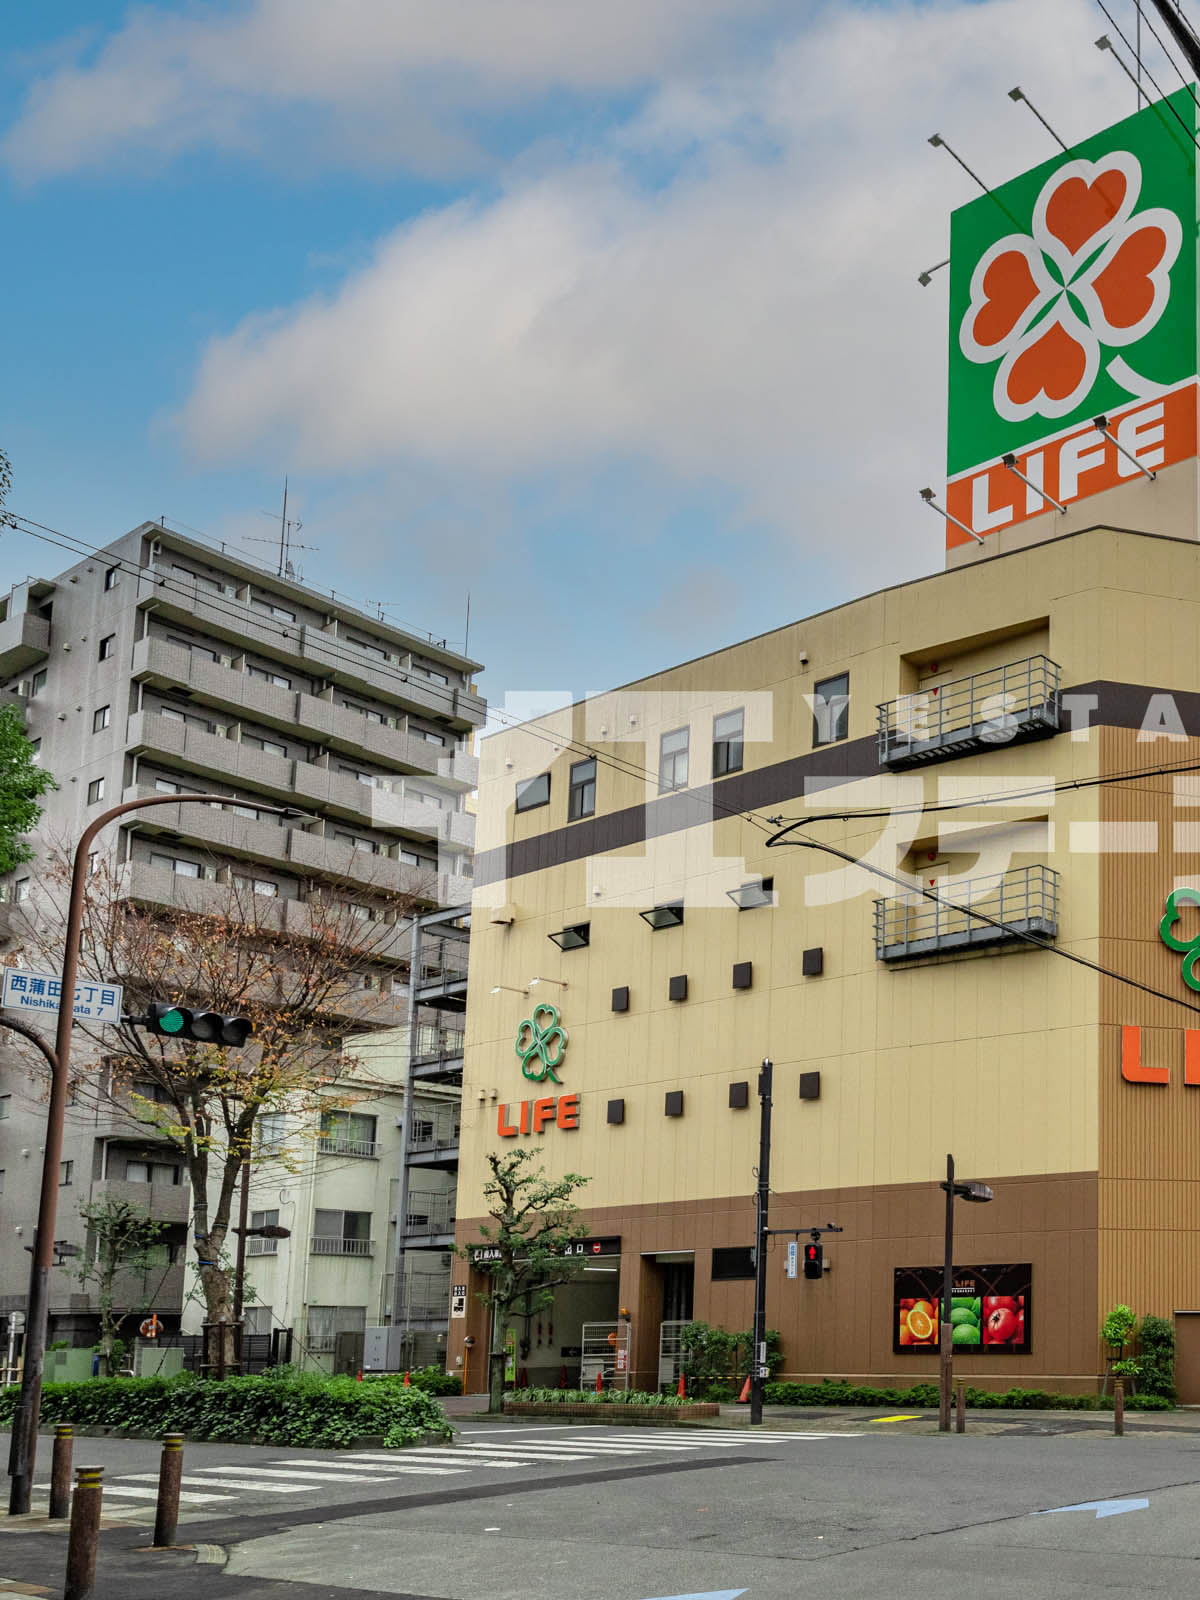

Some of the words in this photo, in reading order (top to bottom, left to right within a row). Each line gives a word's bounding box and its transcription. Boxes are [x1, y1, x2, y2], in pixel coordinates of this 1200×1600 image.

[972, 402, 1165, 533] LIFE
[20, 995, 91, 1015] Nishikaata
[97, 1007, 104, 1016] 7
[497, 1093, 580, 1137] LIFE
